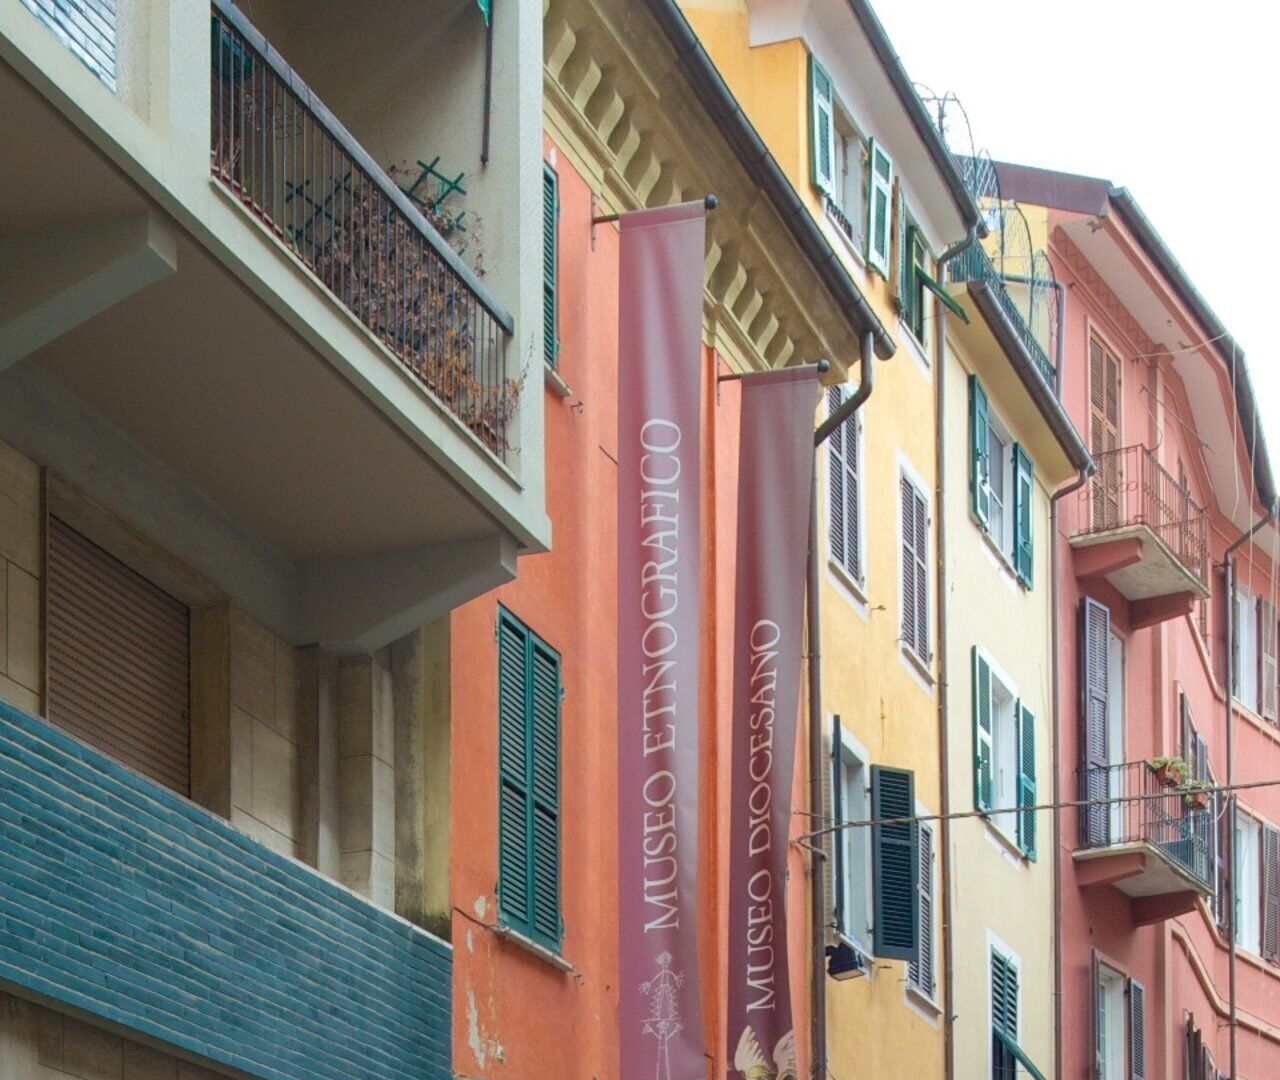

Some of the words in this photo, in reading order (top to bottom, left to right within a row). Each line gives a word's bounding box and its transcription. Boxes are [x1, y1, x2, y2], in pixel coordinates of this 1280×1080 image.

[640, 416, 682, 758] ETNOGRAFICO
[748, 618, 781, 858] DIOCESANO
[642, 768, 679, 933] MUSEO
[746, 868, 775, 1013] MUSEO
